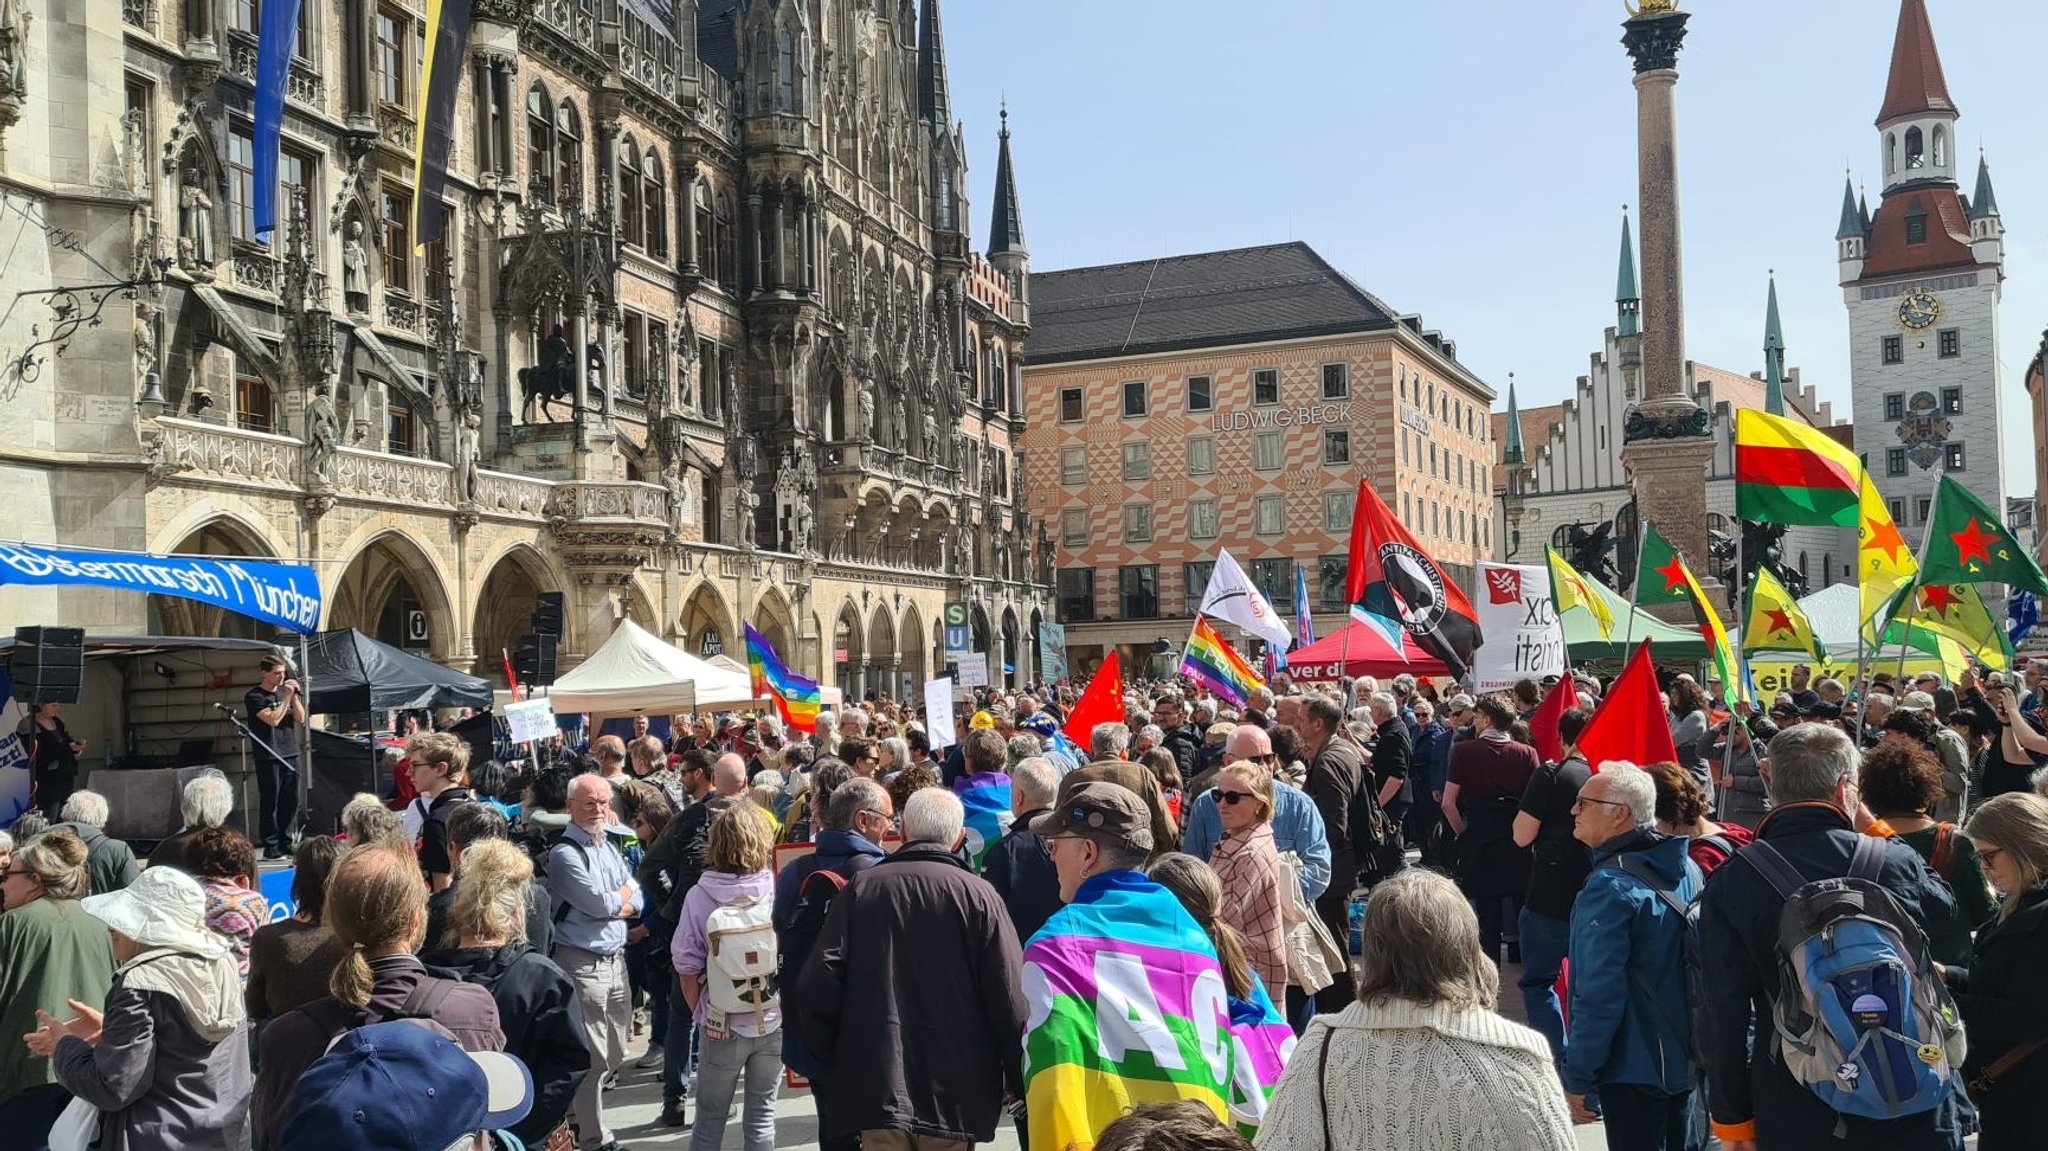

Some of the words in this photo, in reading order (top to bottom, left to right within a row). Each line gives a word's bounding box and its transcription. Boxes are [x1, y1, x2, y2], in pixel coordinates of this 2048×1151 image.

[1212, 408, 1293, 432] LUDWIG
[1299, 402, 1352, 426] BECK
[218, 562, 319, 634] München
[948, 605, 964, 624] S
[950, 629, 963, 647] U
